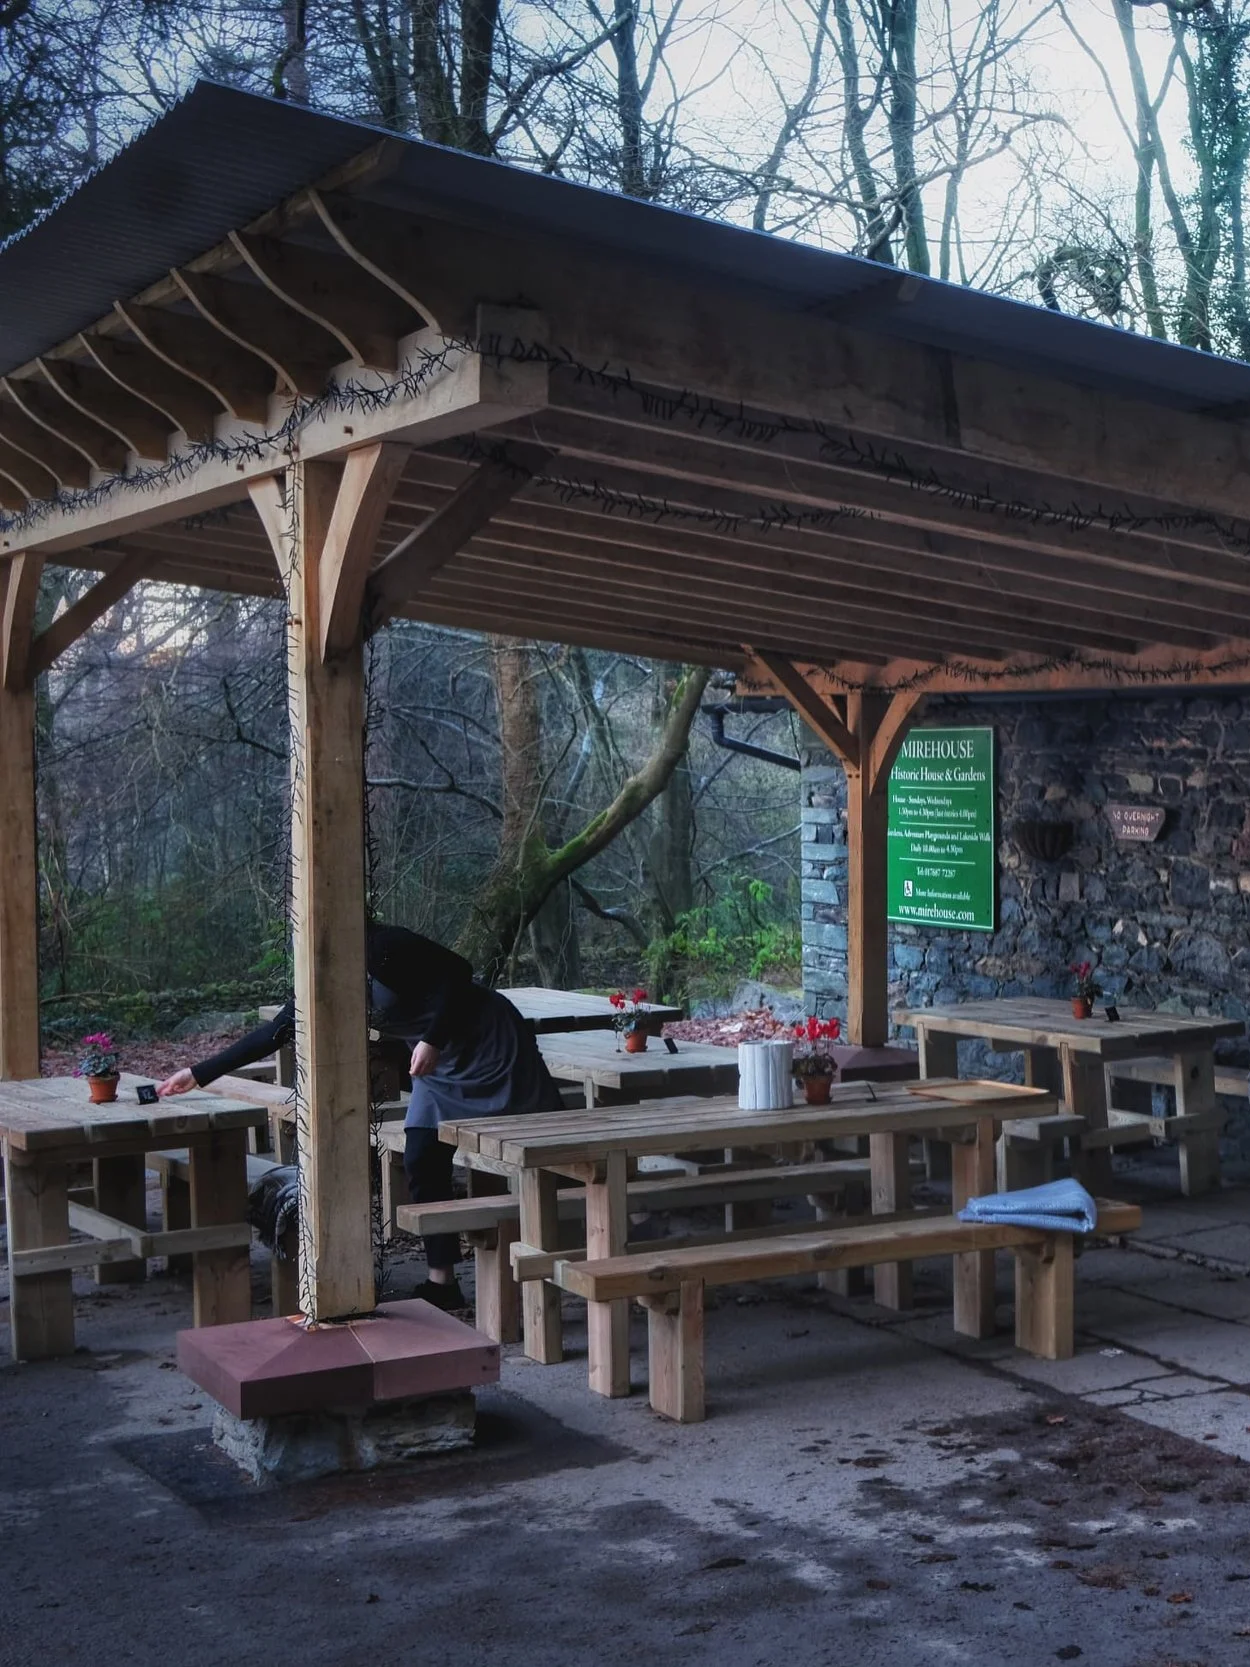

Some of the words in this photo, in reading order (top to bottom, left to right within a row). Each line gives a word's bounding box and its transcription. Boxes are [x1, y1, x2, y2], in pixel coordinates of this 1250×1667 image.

[901, 739, 975, 759] MIREHOUSE
[890, 766, 919, 780] Historic
[920, 767, 945, 781] House
[945, 768, 953, 782] &
[953, 766, 986, 782] Gardens
[1112, 811, 1120, 820] NO
[1123, 811, 1160, 823] OVERNIGHT
[1122, 824, 1149, 836] PARKING
[899, 903, 974, 921] www.mirehouse.com
